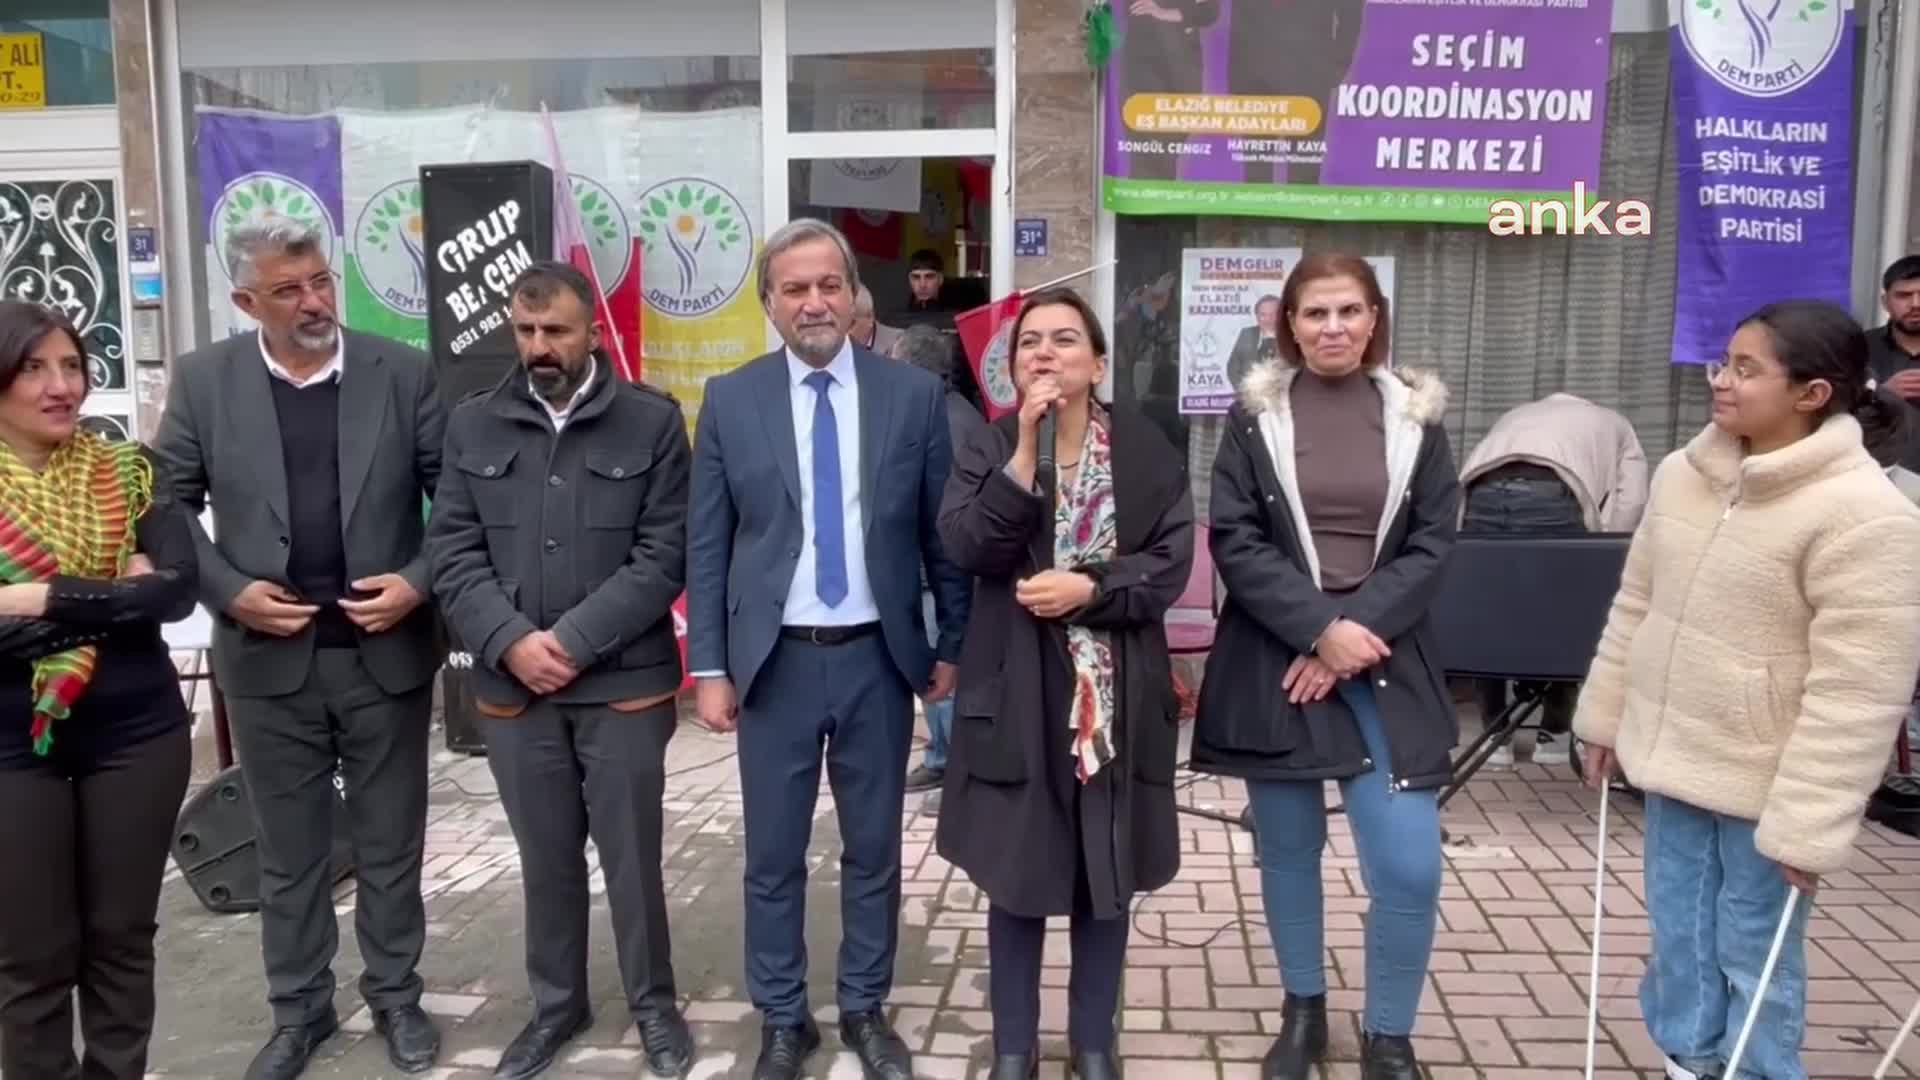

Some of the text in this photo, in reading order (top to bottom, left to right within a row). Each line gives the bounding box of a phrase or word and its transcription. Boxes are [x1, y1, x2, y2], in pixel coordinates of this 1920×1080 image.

[1411, 29, 1525, 72] SEÇİM
[1717, 57, 1805, 88] DEM PARTİ
[1155, 97, 1289, 115] ELAZIĞ BELEDİYE
[1337, 81, 1593, 121] KOORDİNASYON
[1159, 115, 1223, 131] BAŞKAN
[1226, 116, 1308, 132] ADAYLARI
[1695, 116, 1828, 142] HALKLARIN
[1117, 140, 1165, 154] SONGÜL
[1297, 141, 1329, 154] KAYA
[1376, 134, 1543, 173] MERKEZİ
[1702, 146, 1822, 176] EŞİTLİK VE
[1699, 184, 1826, 210] DEMOKRASİ
[437, 199, 521, 273] GRUP
[1720, 217, 1803, 243] PARTİSİ
[384, 287, 415, 311] DEM
[649, 282, 726, 312] DEM PARTİ
[450, 326, 481, 356] 0531
[479, 310, 504, 335] 982
[1187, 373, 1224, 385] KAYA
